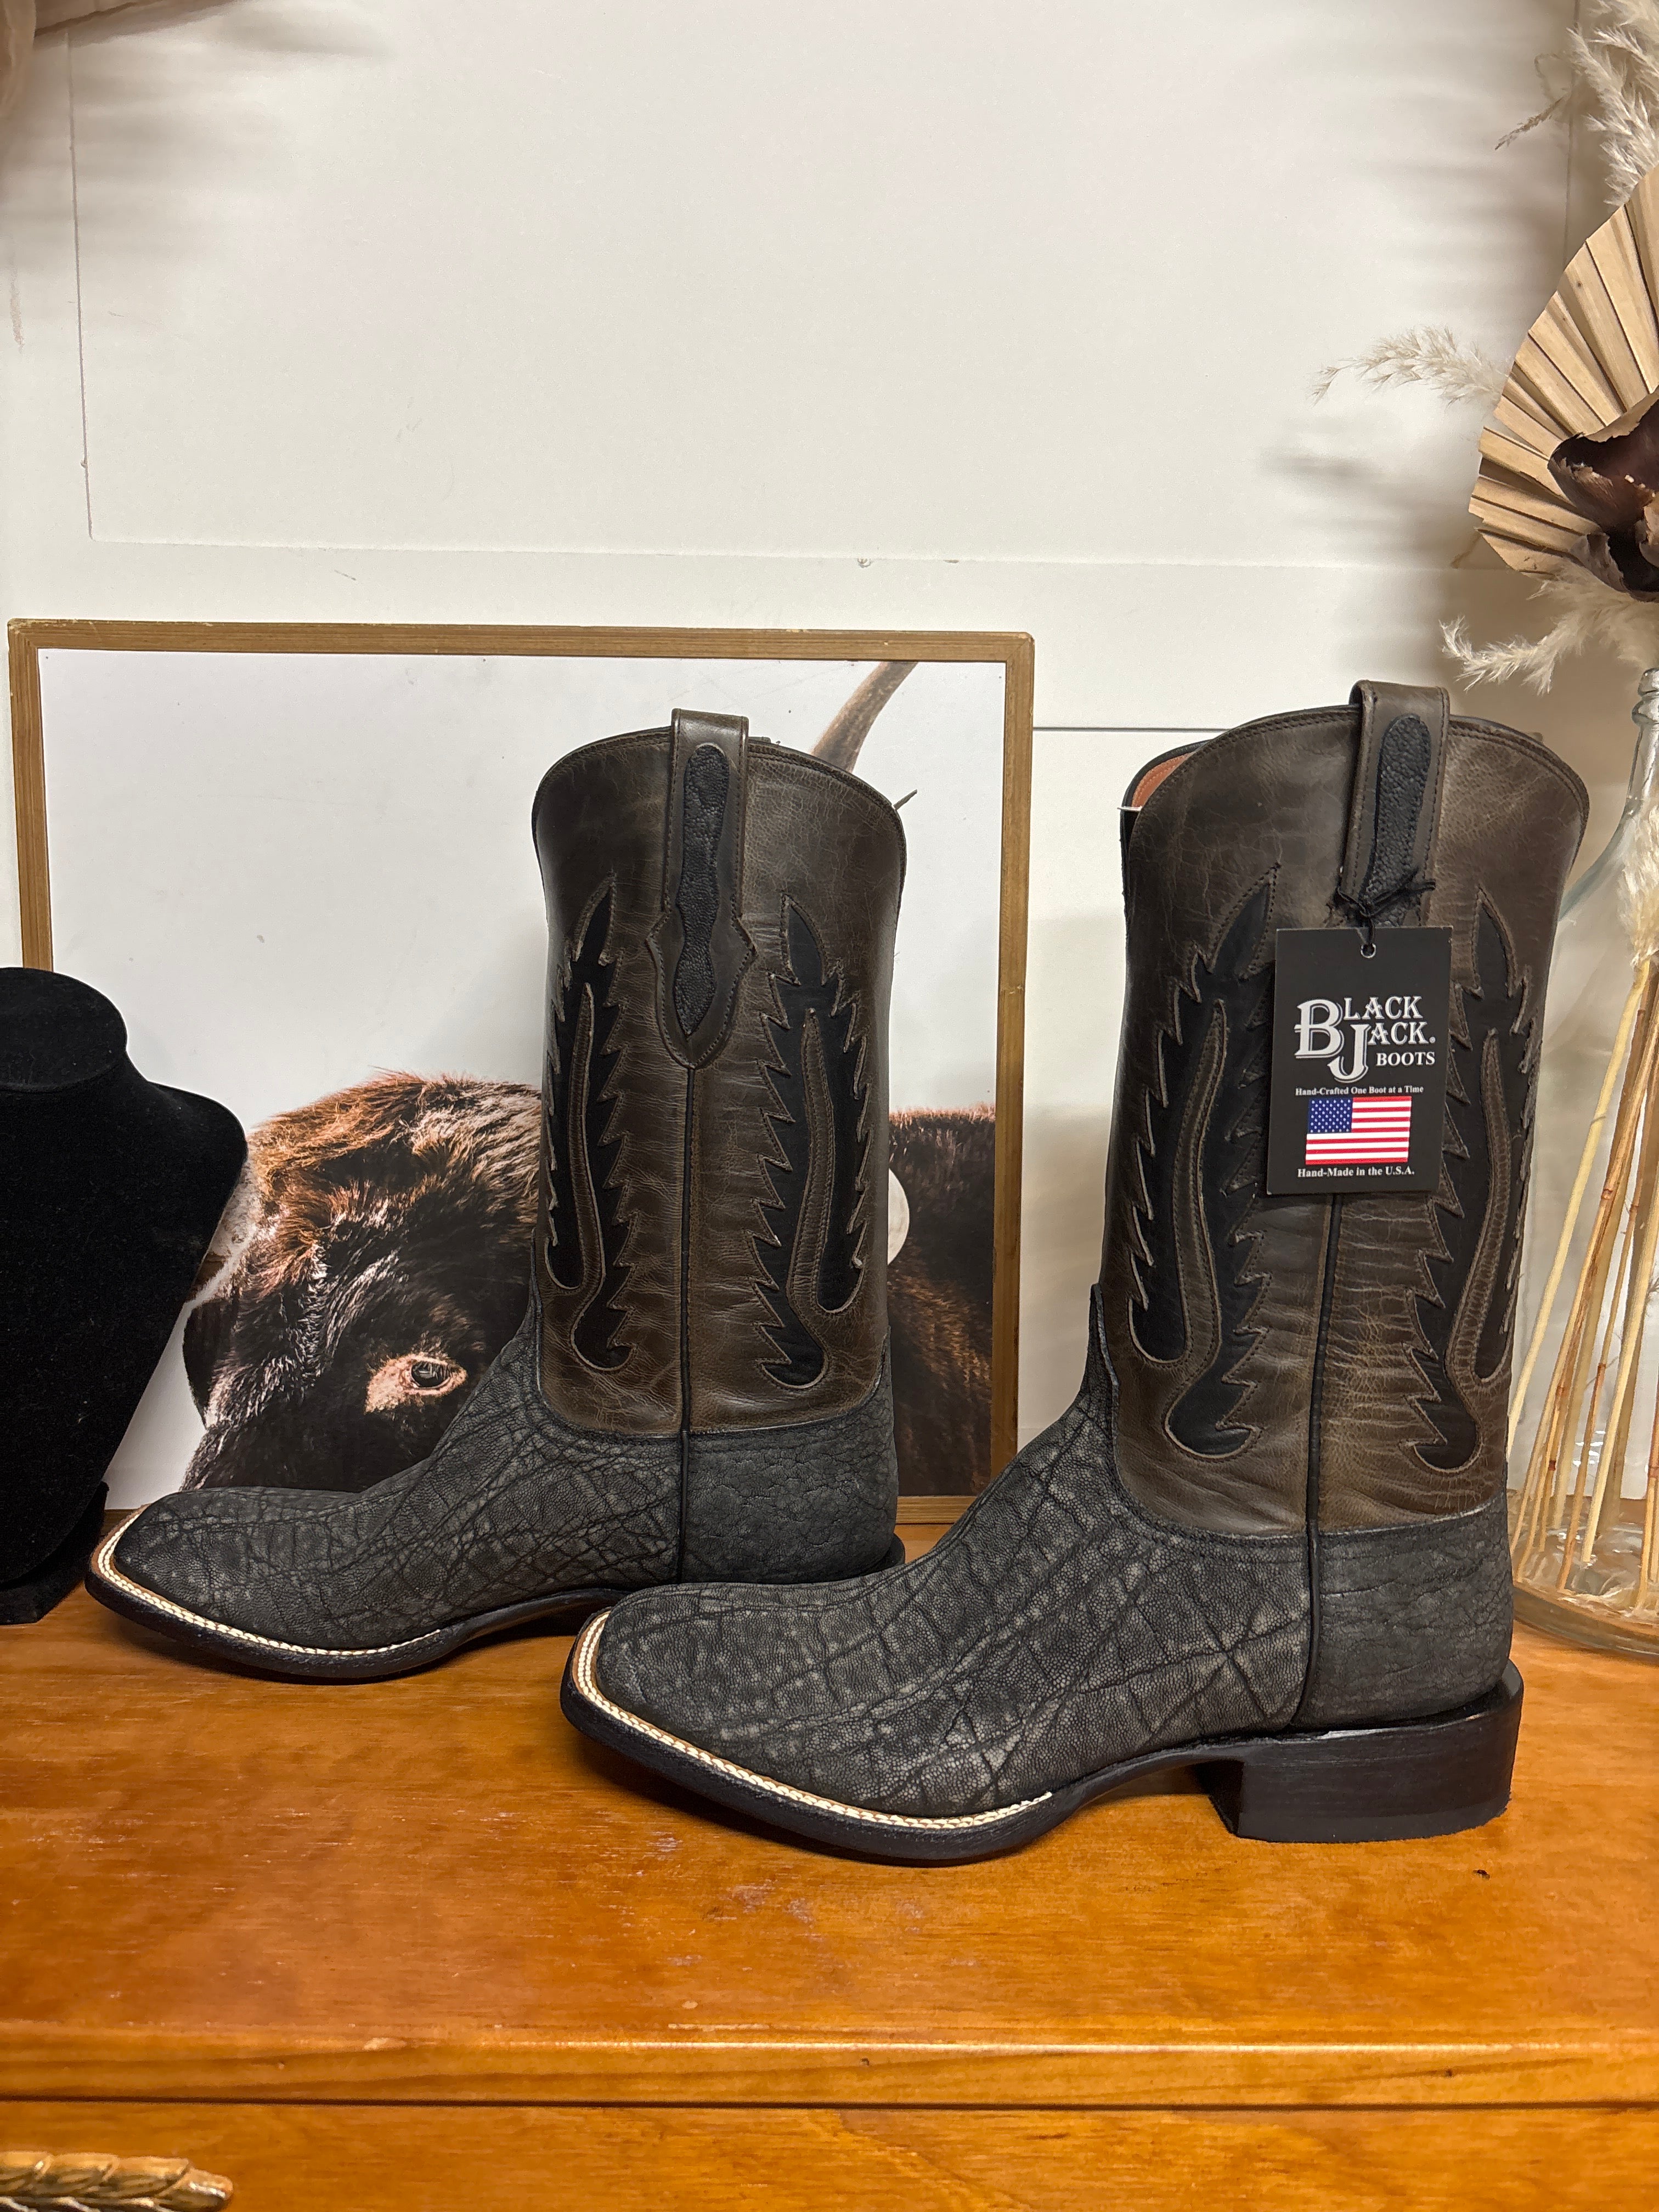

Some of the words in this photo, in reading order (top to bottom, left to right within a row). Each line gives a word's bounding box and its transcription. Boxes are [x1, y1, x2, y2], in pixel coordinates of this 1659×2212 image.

[1294, 996, 1424, 1058] BLACK
[1376, 1051, 1435, 1066] BOOTS
[1295, 1087, 1348, 1096] Hand-Crafted
[1404, 1085, 1424, 1093] Time
[1297, 1167, 1354, 1177] Hand-Made
[1356, 1167, 1365, 1176] in
[1368, 1166, 1383, 1176] the
[1385, 1165, 1415, 1176] U.S.A.
